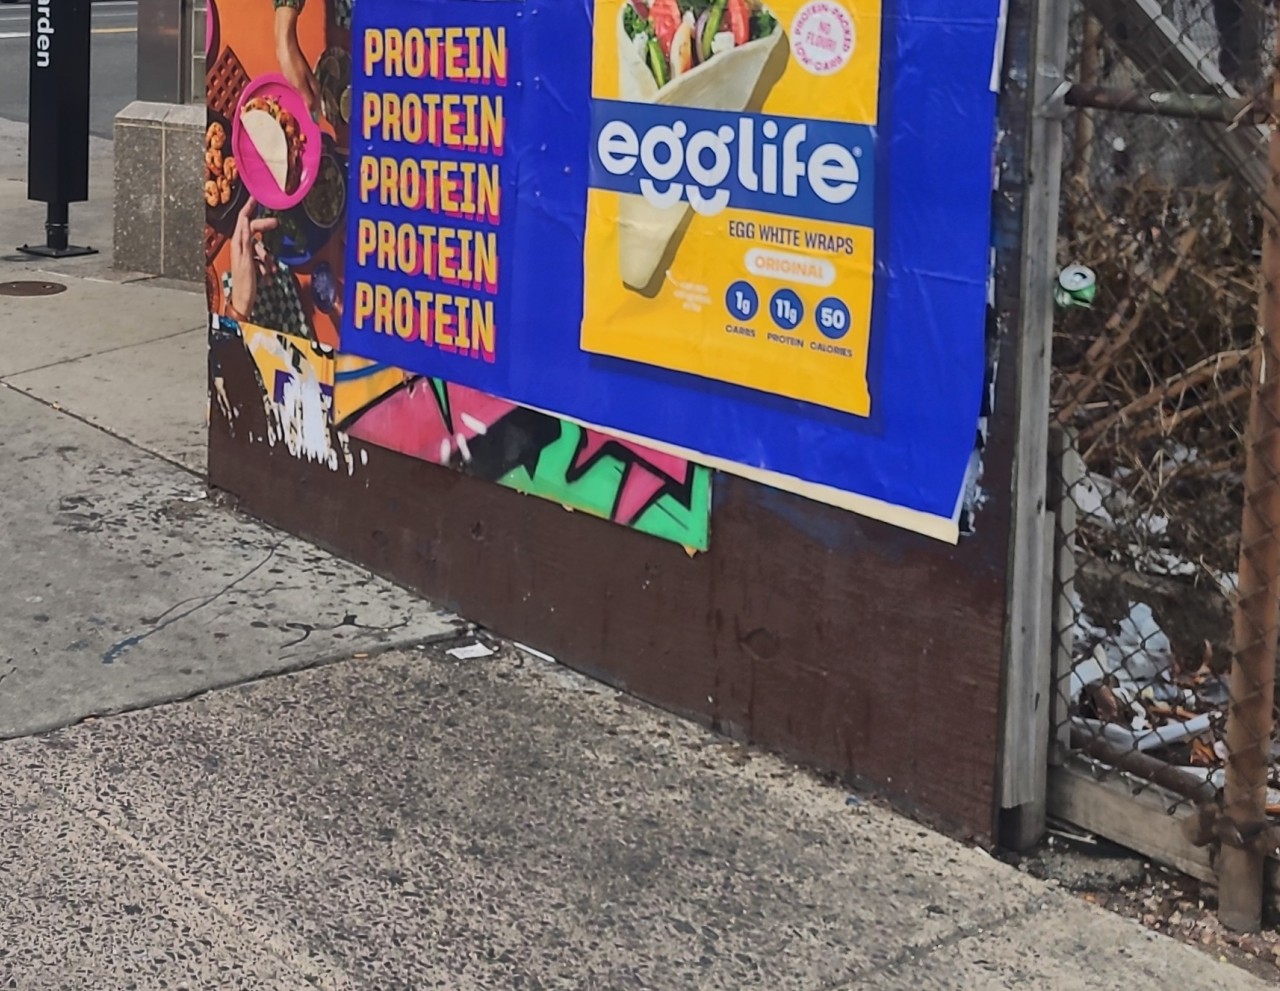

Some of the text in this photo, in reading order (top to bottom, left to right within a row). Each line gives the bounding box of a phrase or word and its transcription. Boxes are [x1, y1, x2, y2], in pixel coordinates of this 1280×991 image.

[364, 26, 507, 83] PROTEIN
[362, 92, 503, 151] PROTEIN
[360, 155, 499, 220] PROTEIN
[729, 220, 854, 255] EGG WHITE WRAPS
[358, 218, 497, 290] PROTEIN
[754, 255, 824, 279] ORIGINAL
[735, 291, 751, 315] 1g
[775, 298, 797, 325] 11g
[354, 281, 494, 358] PROTEIN
[725, 324, 756, 338] CARBS
[821, 307, 846, 330] 50
[767, 333, 804, 348] PROTEIN
[810, 341, 853, 358] CALORIES
